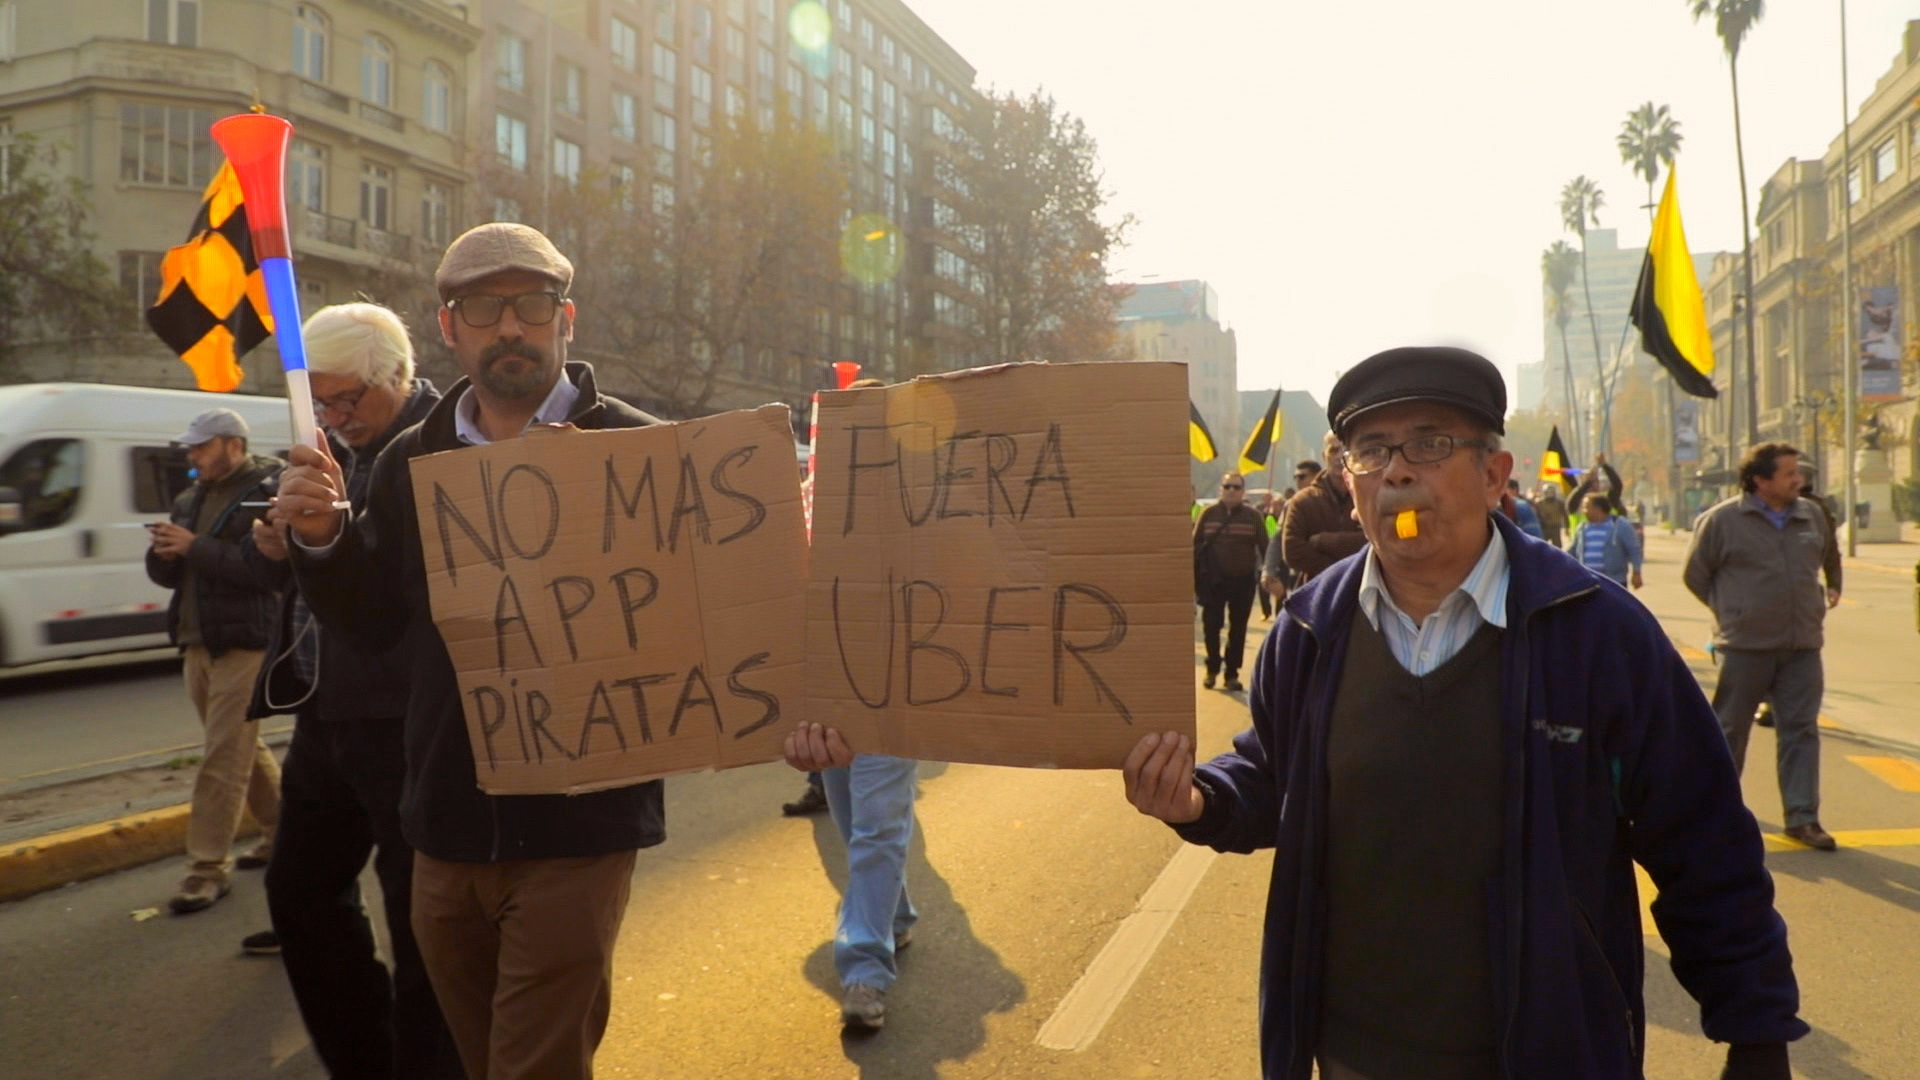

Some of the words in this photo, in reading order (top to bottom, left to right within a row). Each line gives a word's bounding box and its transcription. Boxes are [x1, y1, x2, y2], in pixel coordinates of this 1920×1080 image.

[433, 458, 560, 587] NO
[602, 427, 767, 555] MÁS
[843, 422, 1076, 538] FUERA
[493, 567, 660, 676] APP
[832, 566, 1134, 726] UBER
